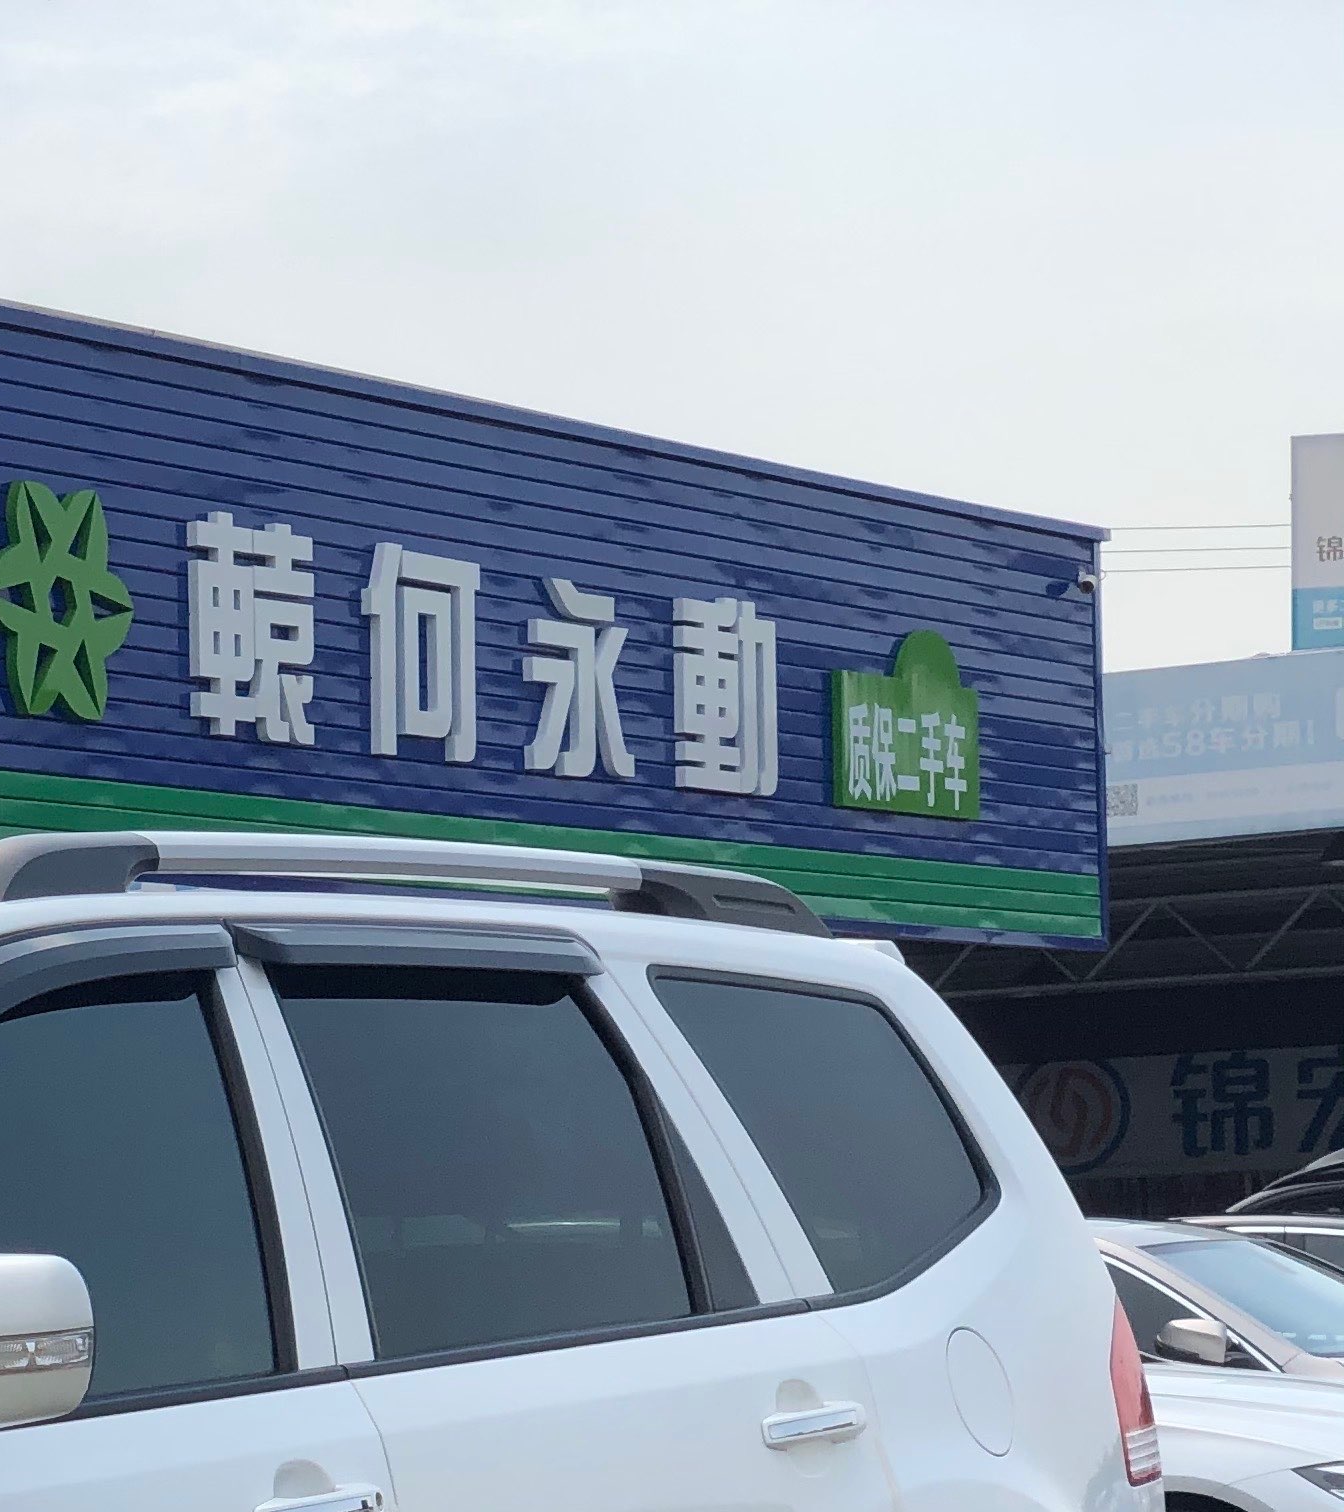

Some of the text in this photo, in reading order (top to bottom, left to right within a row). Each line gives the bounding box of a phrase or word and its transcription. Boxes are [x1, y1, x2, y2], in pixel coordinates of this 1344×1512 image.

[849, 703, 968, 811] 质保二手车
